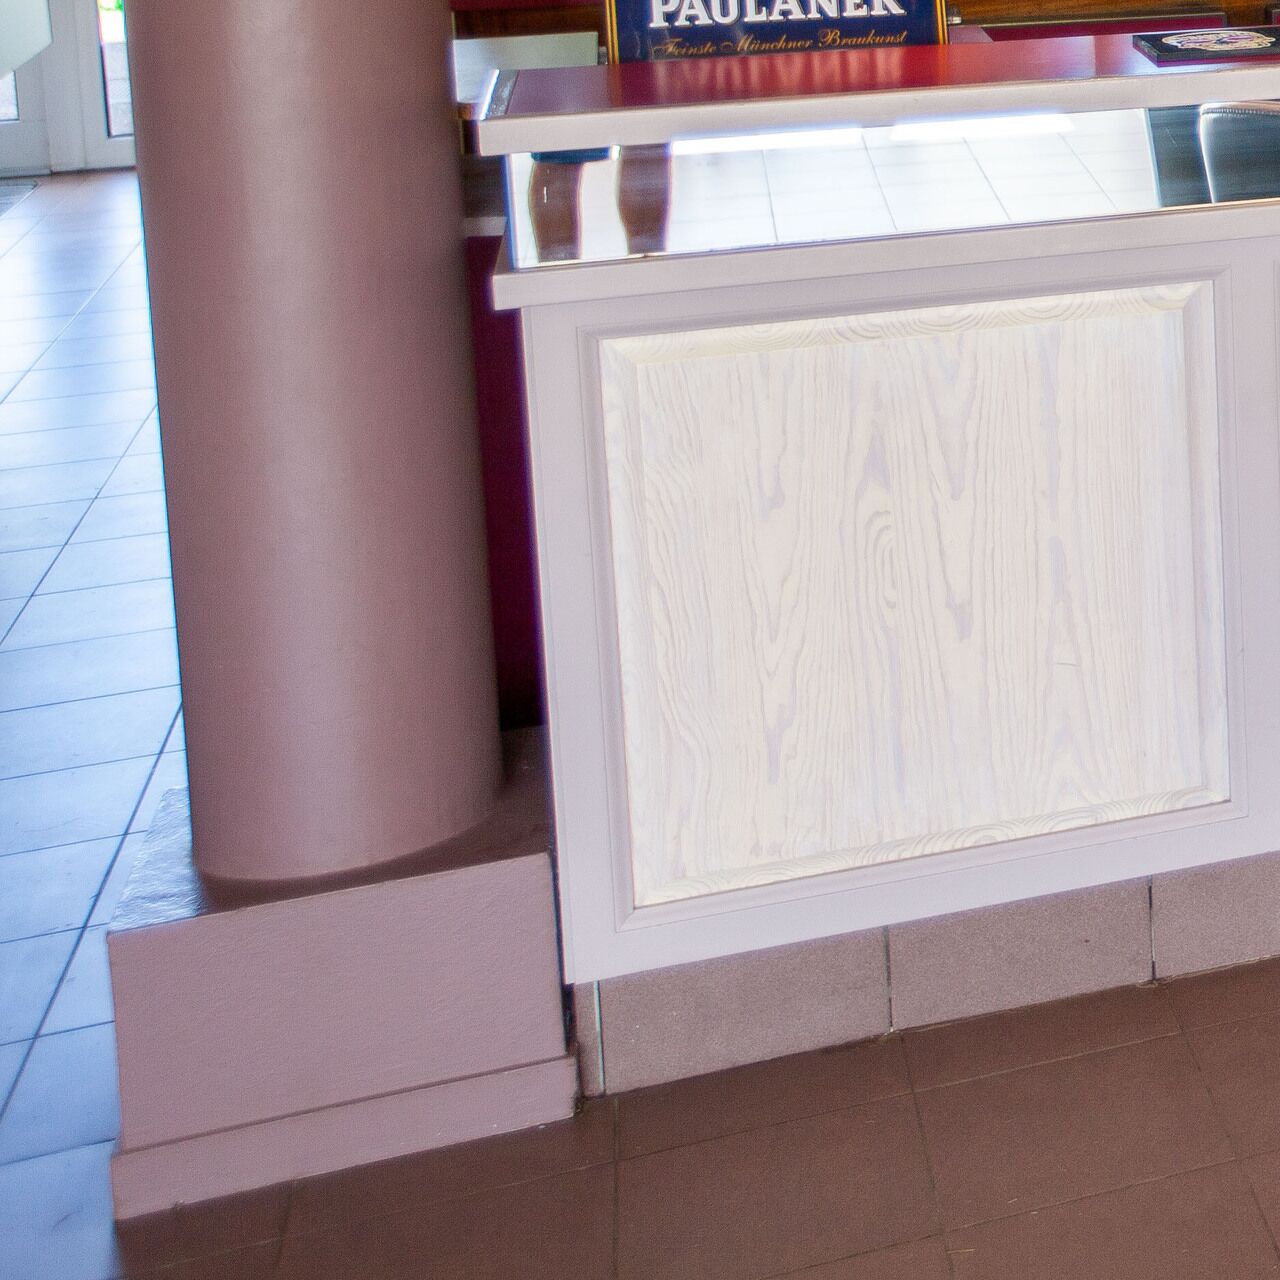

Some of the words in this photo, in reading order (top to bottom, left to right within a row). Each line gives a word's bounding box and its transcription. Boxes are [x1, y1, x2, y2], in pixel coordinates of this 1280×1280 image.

[652, 37, 717, 57] Feinste
[720, 32, 811, 54] Münchner
[818, 27, 907, 48] Braukunst
